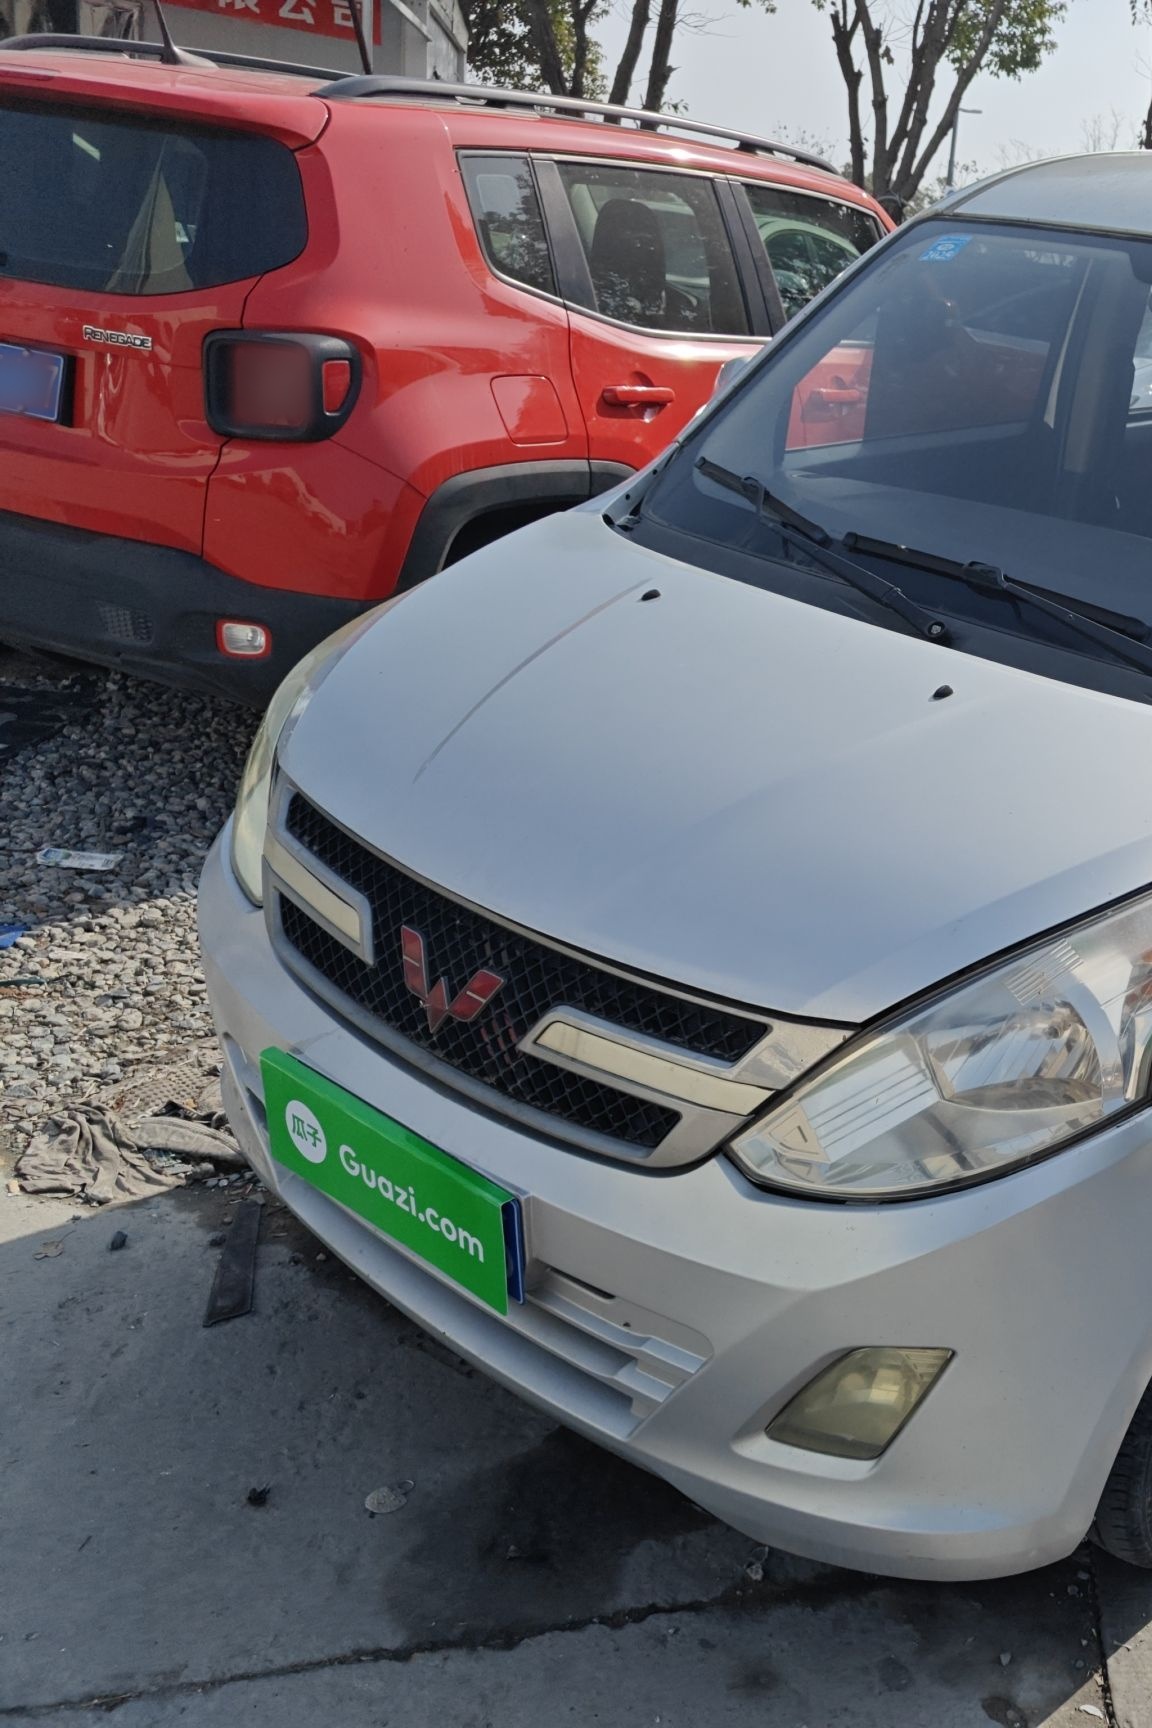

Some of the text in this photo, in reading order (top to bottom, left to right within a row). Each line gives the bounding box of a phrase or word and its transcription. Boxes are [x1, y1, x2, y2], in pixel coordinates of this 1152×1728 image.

[83, 324, 152, 351] RENEGADE
[291, 1113, 323, 1148] 瓜子
[339, 1144, 485, 1263] Guazi.com
